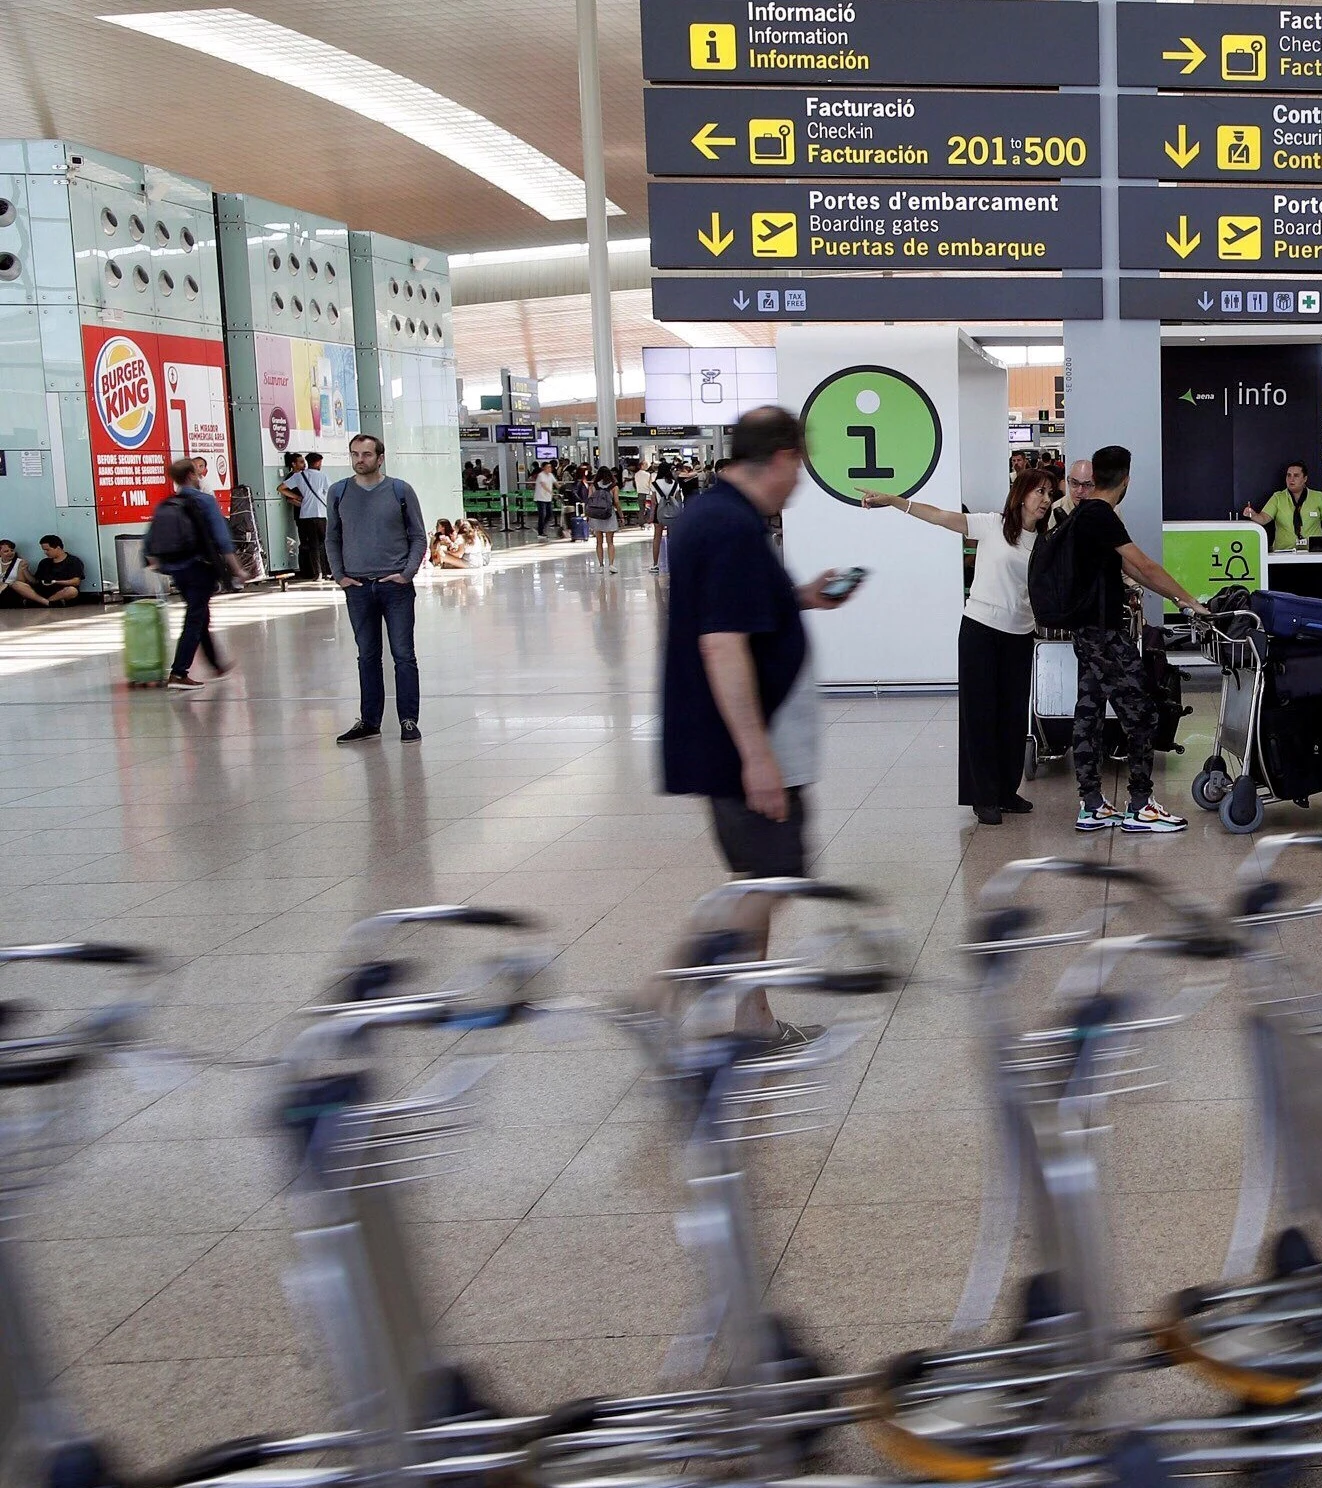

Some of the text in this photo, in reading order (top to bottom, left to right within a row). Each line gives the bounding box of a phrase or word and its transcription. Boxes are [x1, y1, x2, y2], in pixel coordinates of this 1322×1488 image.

[748, 2, 855, 22] Informació
[749, 27, 848, 44] Information
[750, 49, 868, 69] Información
[807, 98, 914, 117] Facturació
[808, 122, 872, 138] Check-in
[808, 144, 928, 163] Facturación
[948, 136, 1086, 166] 201 to 500
[1012, 155, 1020, 165] a
[810, 191, 1058, 211] Portes d'embarcament
[810, 215, 938, 235] Boarding gates
[811, 237, 1045, 260] Puertas de embarque
[101, 359, 146, 397] BURGER
[104, 378, 150, 424] KING
[1238, 382, 1287, 406] info
[96, 454, 164, 465] BEFORE SECURITY CONTROL
[115, 466, 134, 475] CONTROL
[115, 476, 134, 485] CONTROL
[122, 490, 149, 506] 1 MIN.
